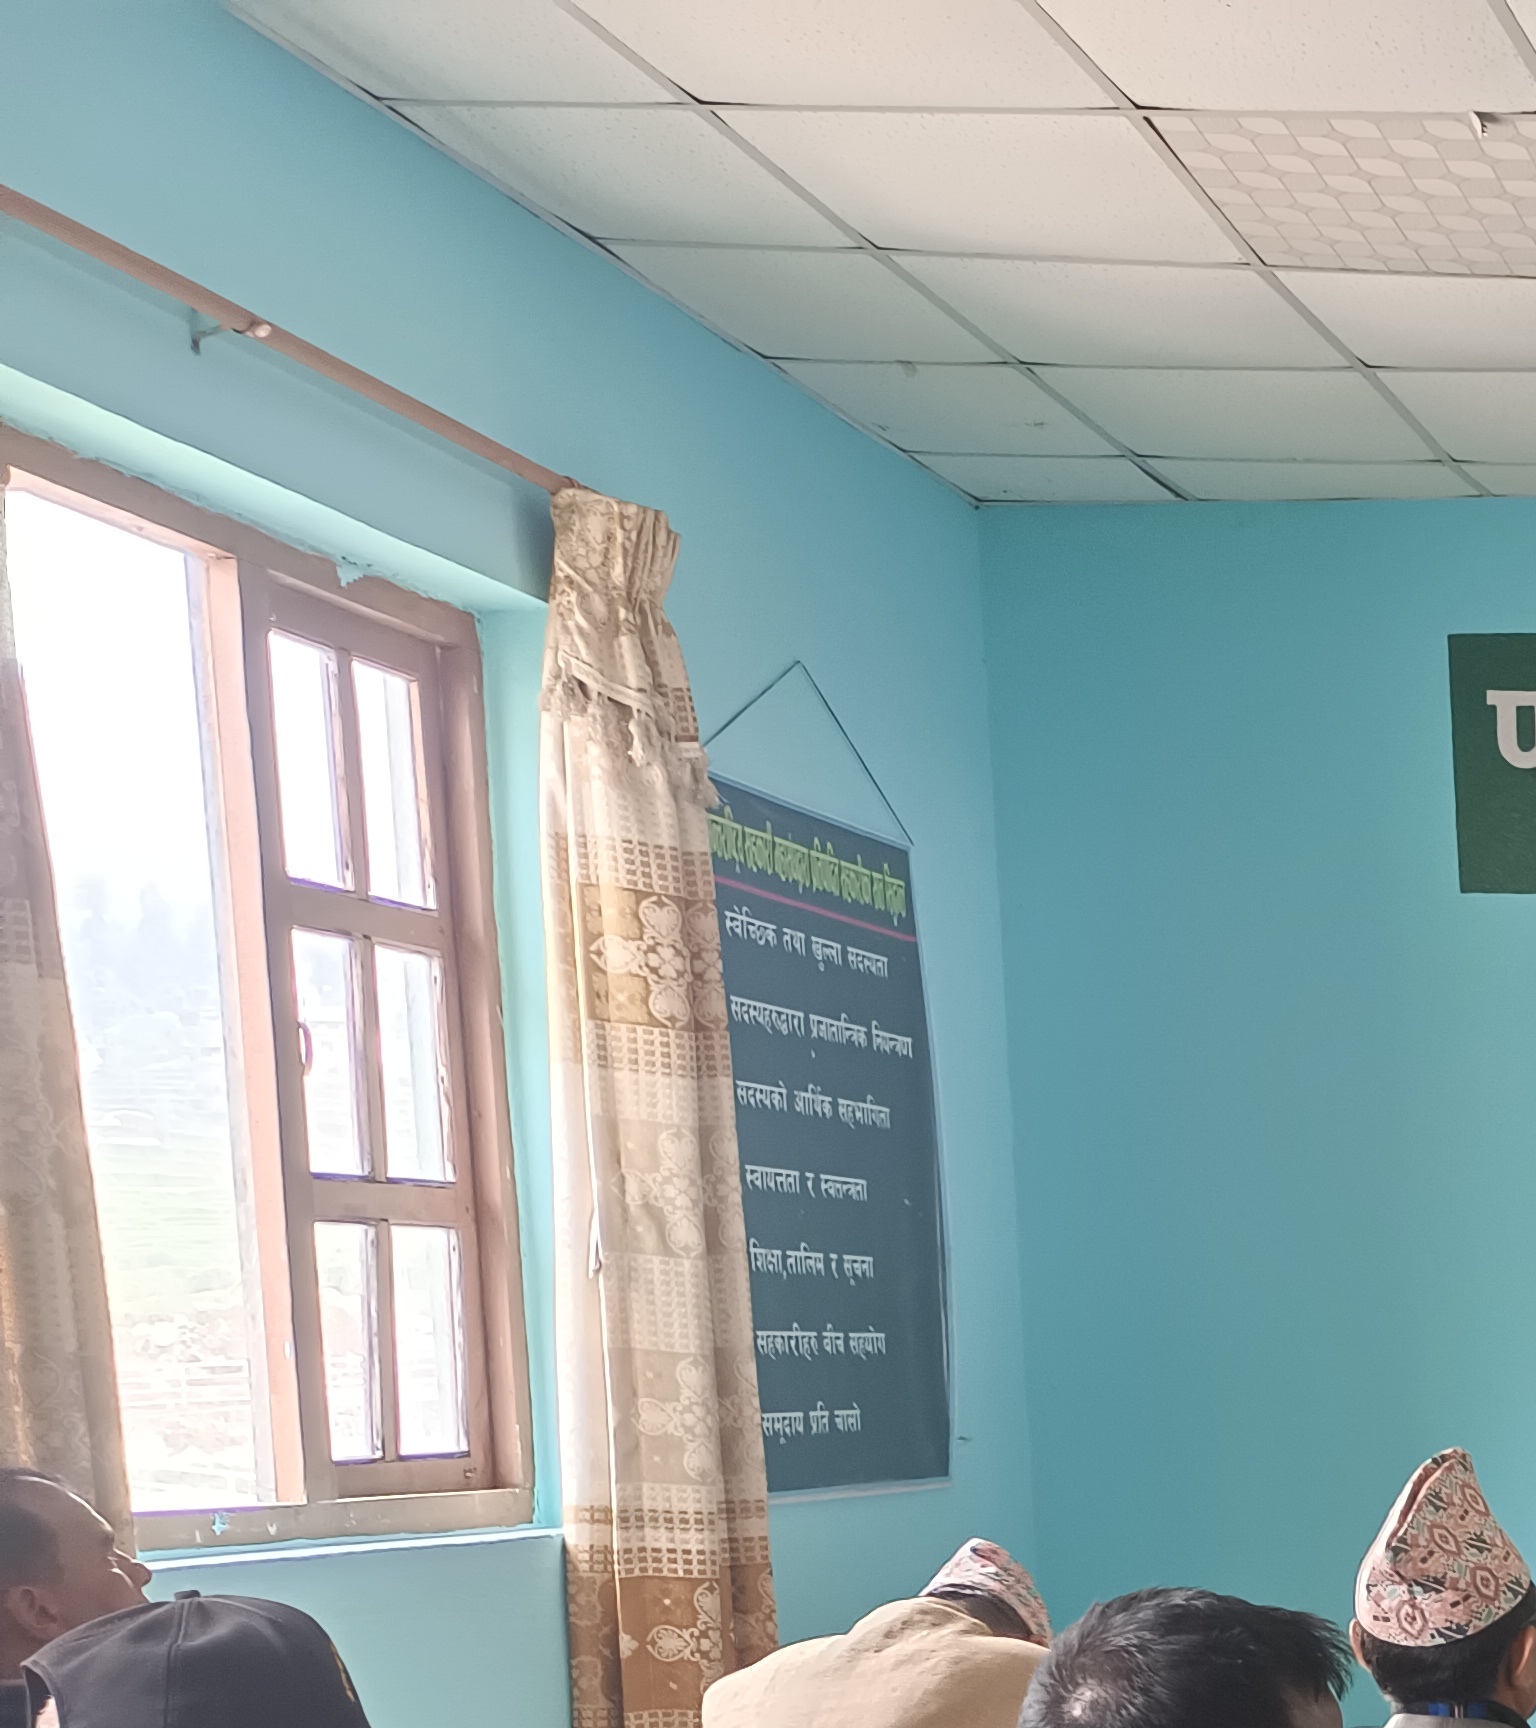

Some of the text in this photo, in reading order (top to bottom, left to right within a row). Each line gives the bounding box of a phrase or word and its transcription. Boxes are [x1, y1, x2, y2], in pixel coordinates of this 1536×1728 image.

[782, 928, 806, 957] तथा
[735, 1080, 788, 1113] सदस्यको
[794, 1083, 833, 1119] आर्थिक
[805, 1172, 816, 1199] र
[829, 1252, 839, 1280] र
[849, 1325, 886, 1361] सहयोग
[809, 1400, 830, 1436] प्रति
